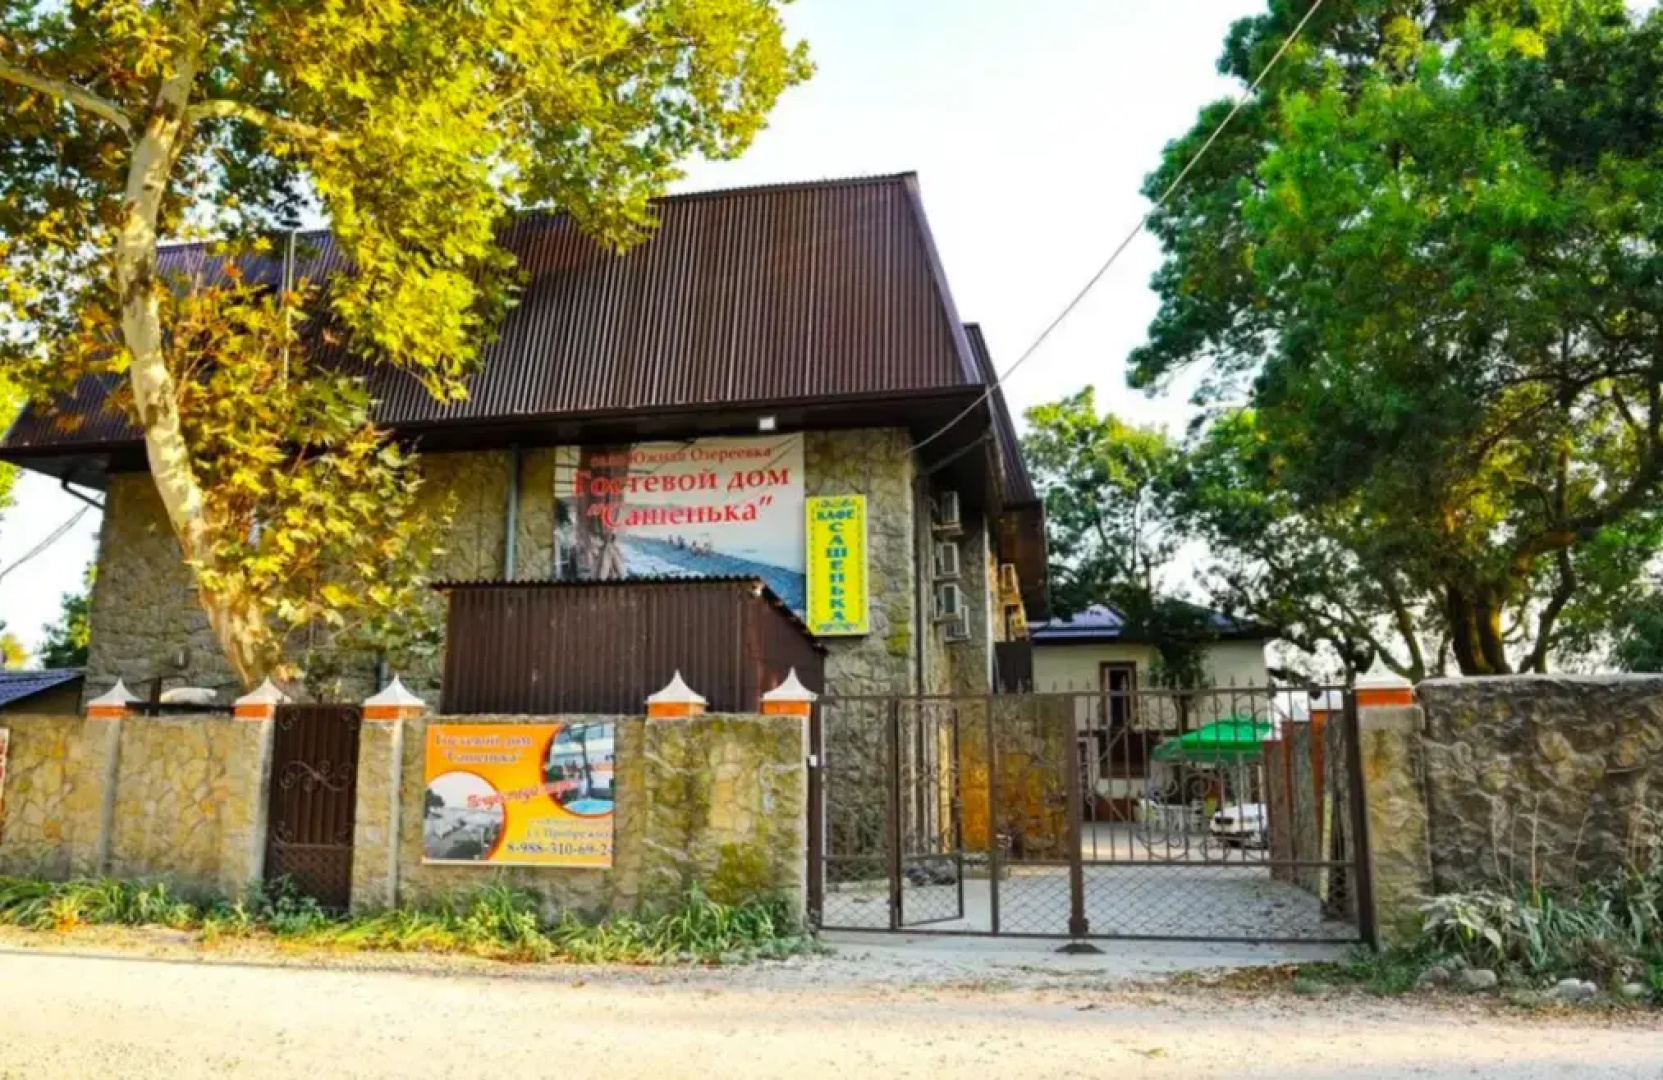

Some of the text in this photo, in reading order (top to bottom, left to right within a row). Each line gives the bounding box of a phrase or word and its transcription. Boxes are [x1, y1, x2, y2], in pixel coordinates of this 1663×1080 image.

[690, 446, 772, 464] Озереевка
[574, 466, 791, 496] Гостевой дом
[816, 508, 855, 520] КАФЕ
[825, 521, 848, 620] САШЕНЬКА
